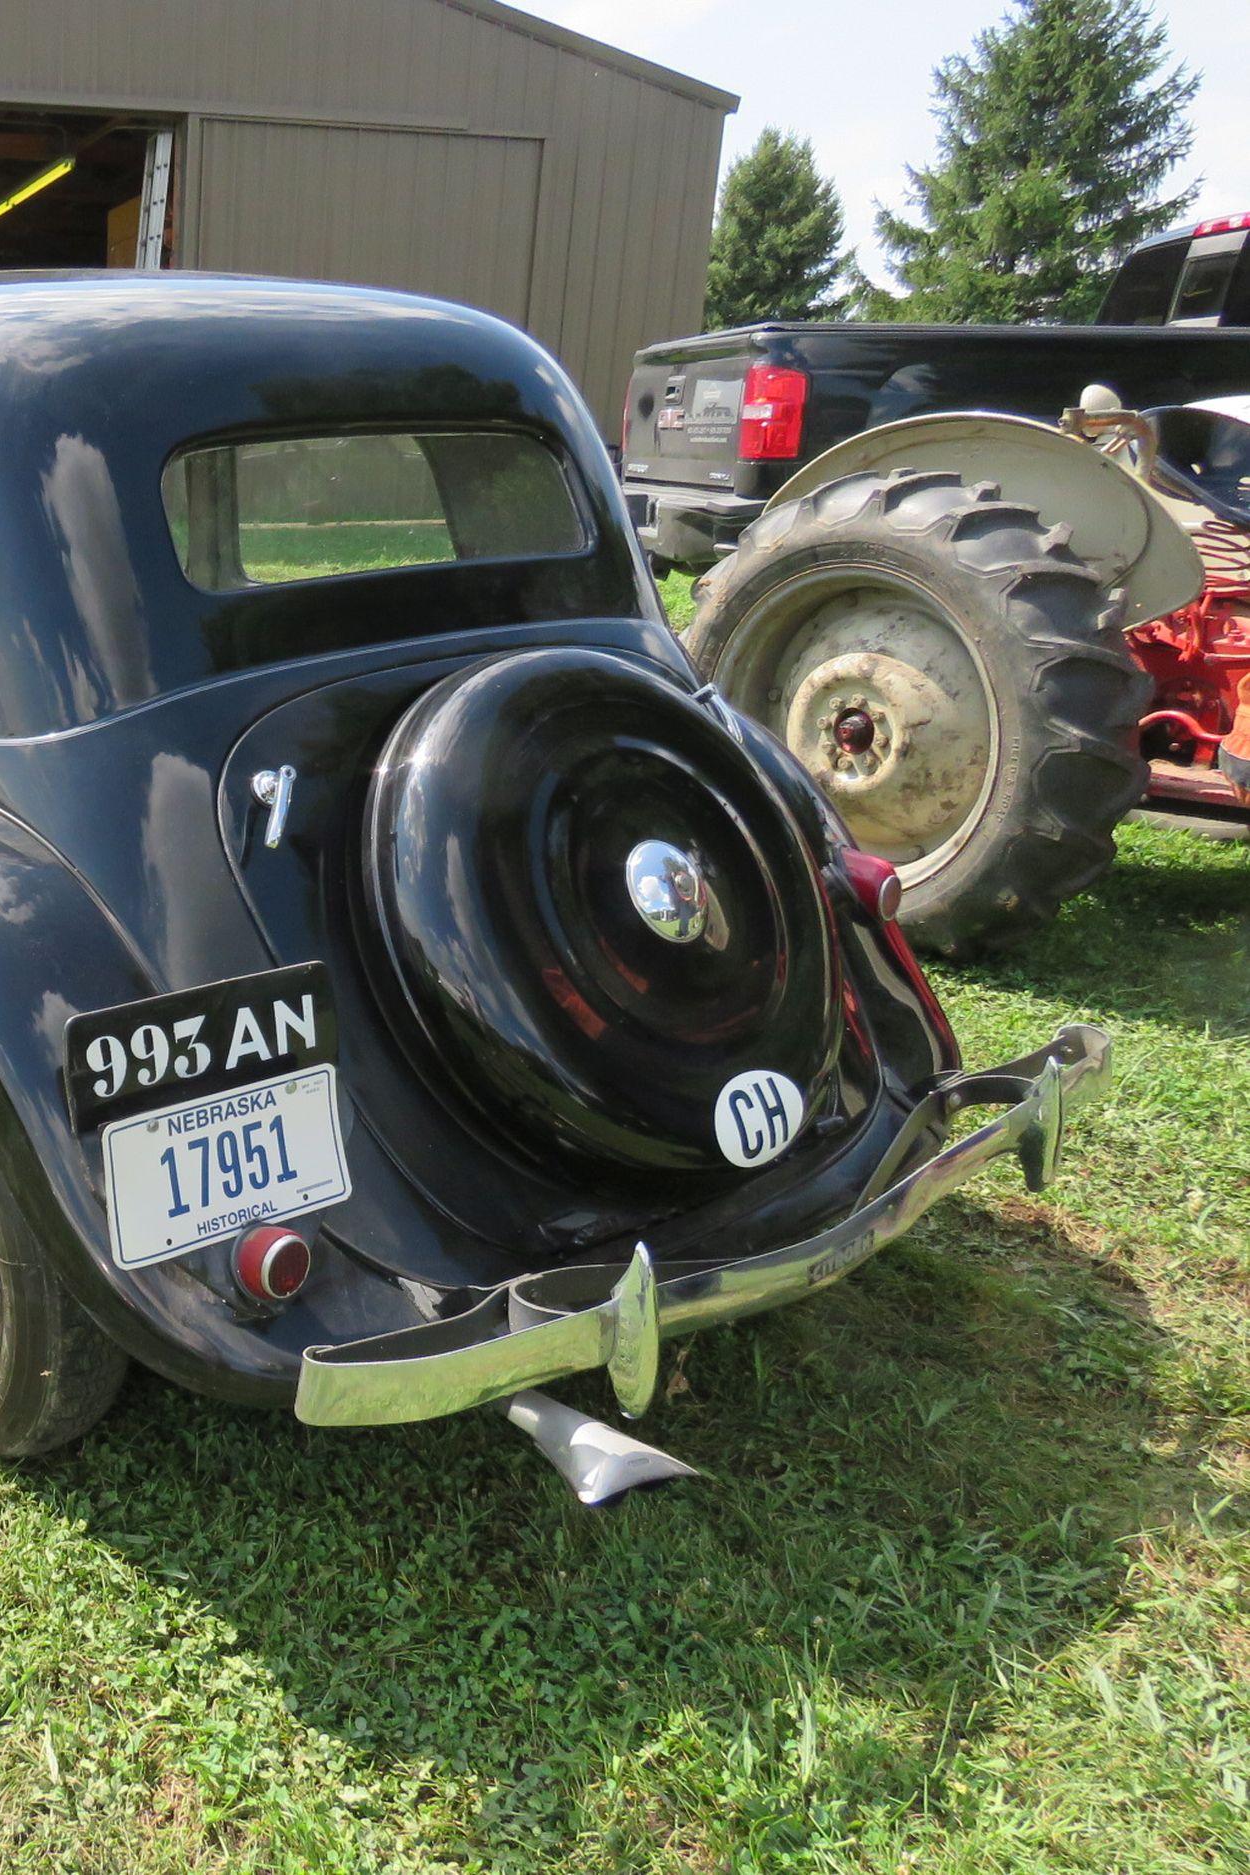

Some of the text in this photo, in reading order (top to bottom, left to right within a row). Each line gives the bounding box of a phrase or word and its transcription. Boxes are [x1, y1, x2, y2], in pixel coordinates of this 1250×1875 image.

[86, 994, 316, 1098] 993 AN
[167, 1090, 277, 1136] NEBRASKA
[728, 1077, 789, 1160] CH
[160, 1114, 298, 1218] 17951
[197, 1200, 278, 1236] HISTORICAL
